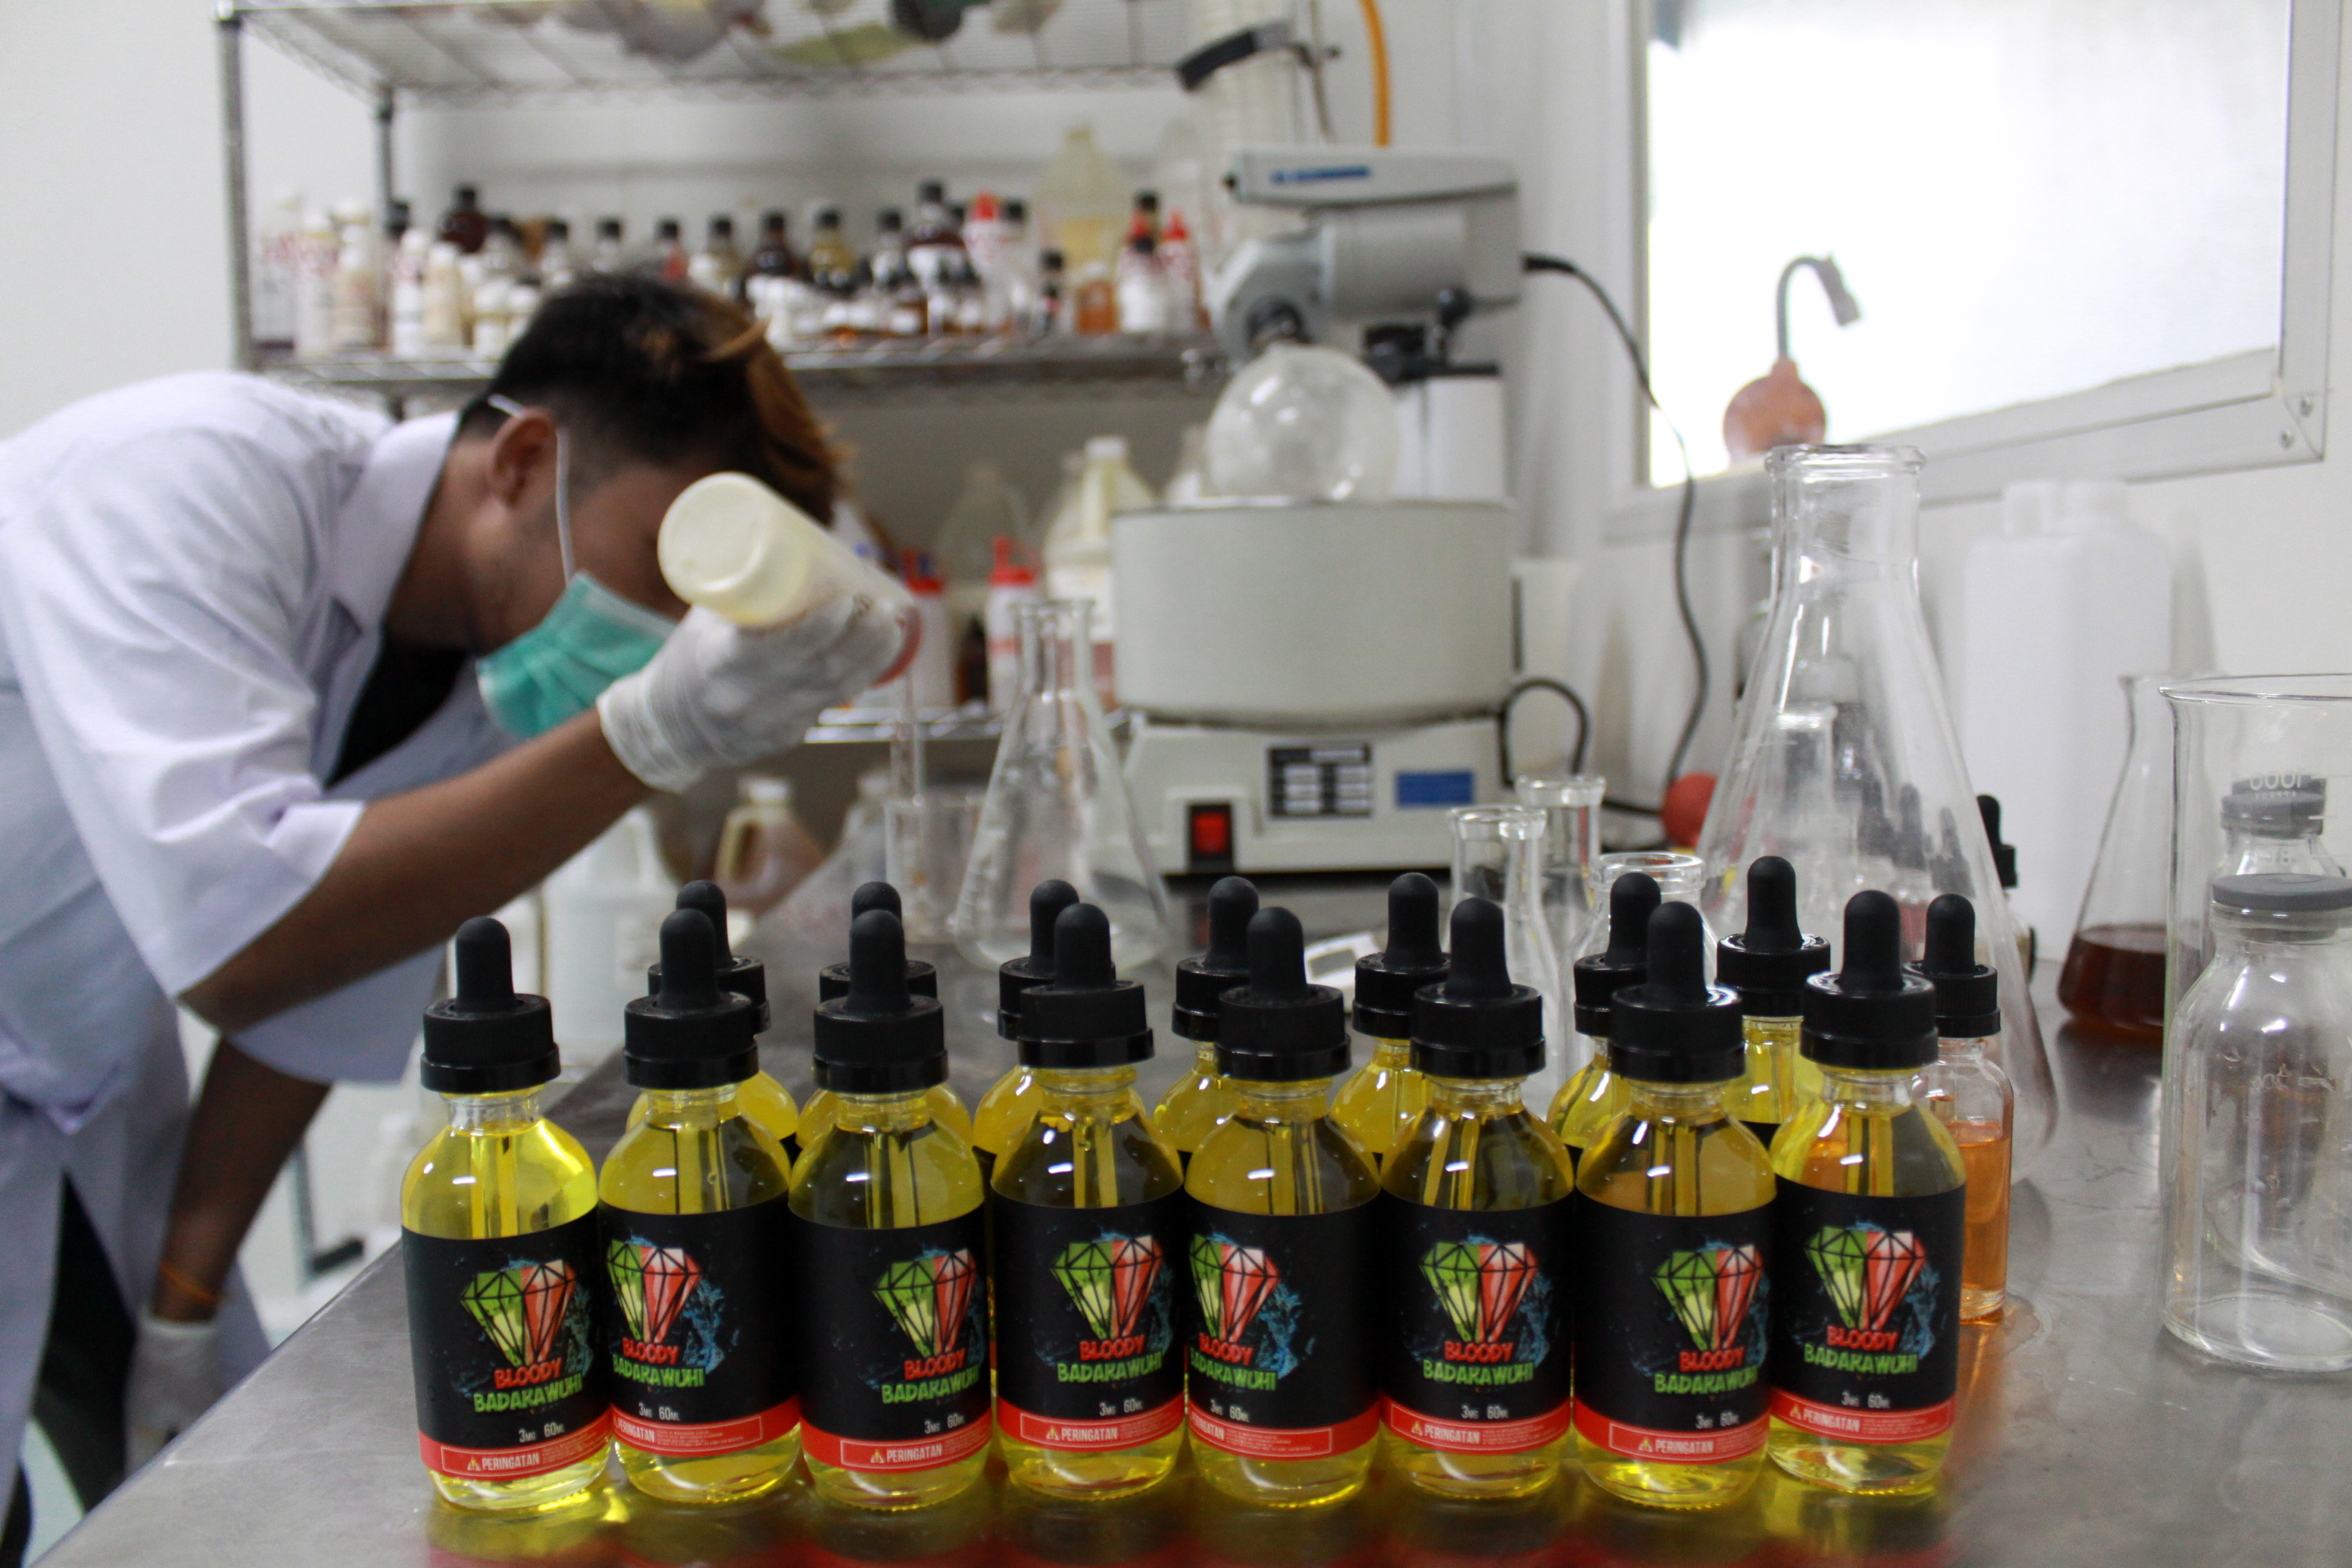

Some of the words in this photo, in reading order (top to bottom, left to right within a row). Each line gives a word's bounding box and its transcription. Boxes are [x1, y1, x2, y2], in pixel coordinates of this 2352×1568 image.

[622, 1337, 679, 1365] BLOODY
[1080, 1334, 1145, 1360] BLOODY
[1199, 1332, 1253, 1366] BLOODY
[1827, 1325, 1899, 1352] BLOODY
[904, 1348, 965, 1380] BLOODY
[1445, 1341, 1515, 1363] BLOODY
[1679, 1346, 1745, 1372] BLOODY
[1804, 1343, 1918, 1374] BADARAWUHI
[494, 1357, 562, 1389] BLOODY
[612, 1353, 704, 1388] BADARAWUHI
[1057, 1352, 1162, 1382] BADARAWUHI
[1423, 1359, 1534, 1385] BADARAWUHI
[473, 1372, 583, 1412] BADARAWUHI
[618, 1416, 655, 1442] PERINGATAN
[1062, 1427, 1117, 1441] PERINGATAN
[1424, 1425, 1480, 1444] PERINGATAN
[482, 1453, 540, 1470] PERINGATAN
[887, 1443, 942, 1462] PERINGATAN
